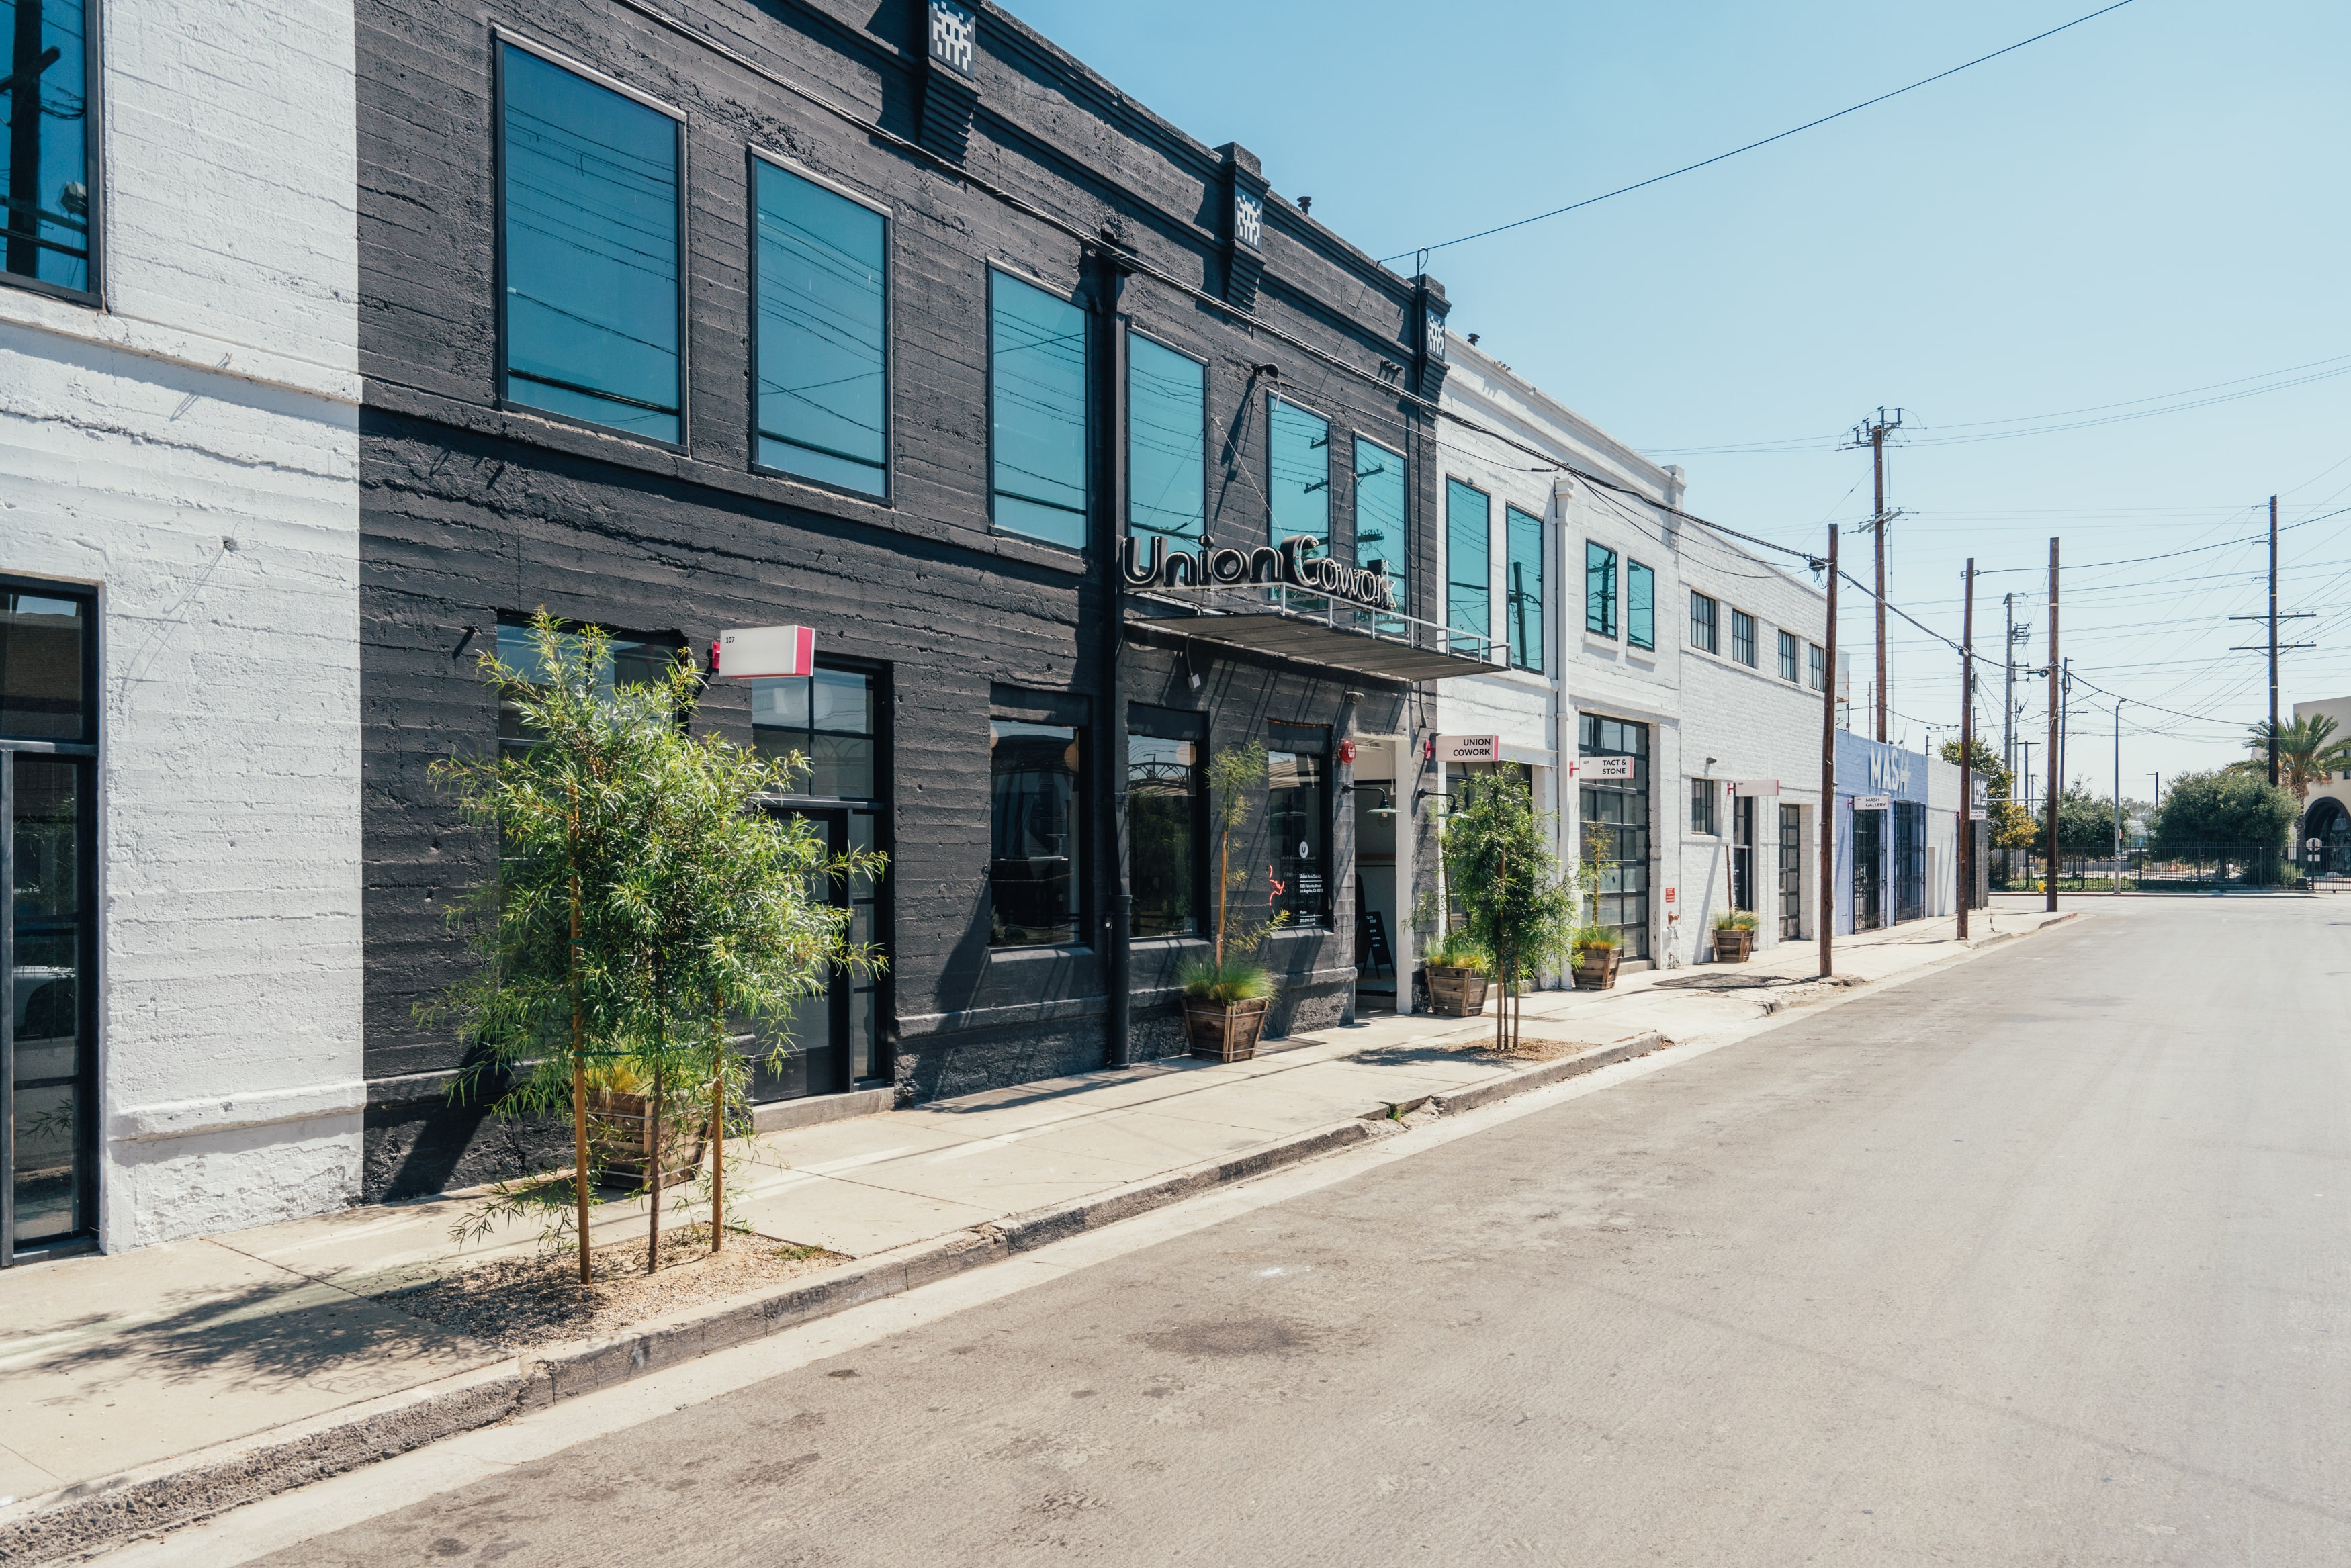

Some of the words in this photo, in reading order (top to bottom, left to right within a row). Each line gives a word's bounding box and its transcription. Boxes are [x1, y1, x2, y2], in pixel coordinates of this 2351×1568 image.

[1122, 534, 1284, 586] Union
[1279, 534, 1397, 609] Cowork
[1453, 748, 1491, 757] COWORK
[1463, 738, 1491, 746] UNION
[1870, 745, 1911, 794] MASH
